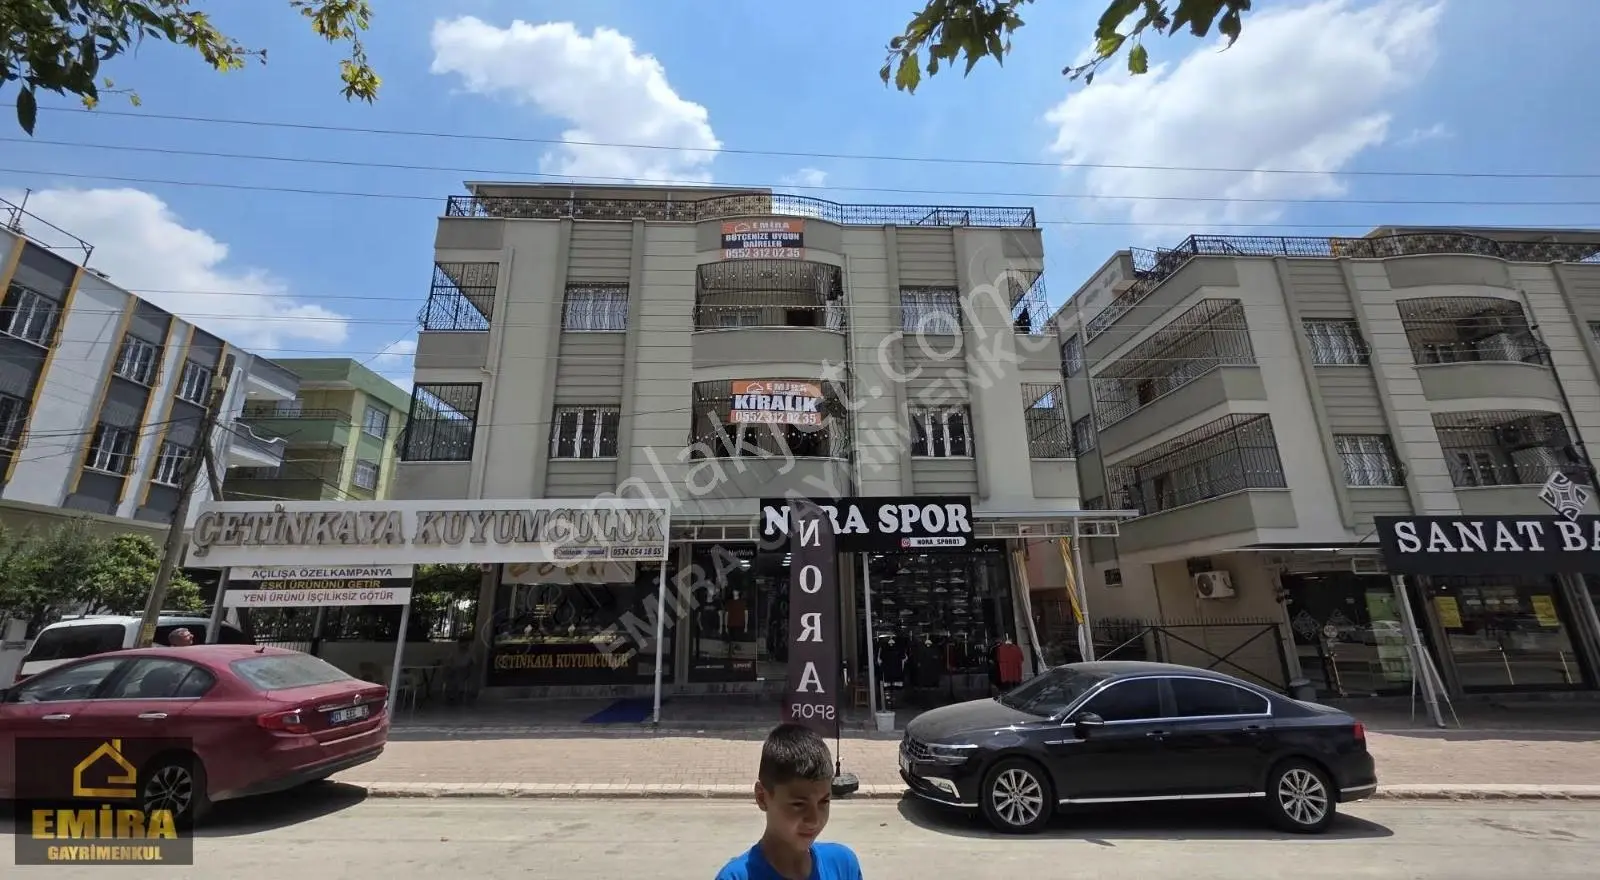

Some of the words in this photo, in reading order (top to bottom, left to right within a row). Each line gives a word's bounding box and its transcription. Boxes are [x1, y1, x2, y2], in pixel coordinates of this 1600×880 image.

[771, 232, 800, 241] UYGUN
[743, 240, 782, 248] DAİRELER
[726, 248, 750, 258] 0552
[753, 248, 770, 258] 312
[772, 248, 785, 258] 02
[787, 248, 800, 258] 35
[734, 394, 817, 412] KİRALIK
[735, 411, 763, 422] 0552
[764, 412, 784, 423] 312
[787, 413, 801, 424] 02
[803, 413, 817, 424] 35
[763, 504, 870, 535] NRA
[878, 503, 972, 534] SPOR
[193, 504, 406, 557] ÇETİNKAYA
[412, 508, 666, 545] KUYUMCULUK
[1394, 521, 1545, 553] SANAT
[1553, 520, 1600, 552] B
[260, 580, 287, 590] ESKİ
[289, 580, 345, 590] ÜRÜNÜNÜ
[348, 579, 381, 589] GETİR
[243, 592, 267, 602] YENİ
[269, 592, 305, 602] ÜRÜNÜ
[359, 590, 394, 601] GÖTÜR
